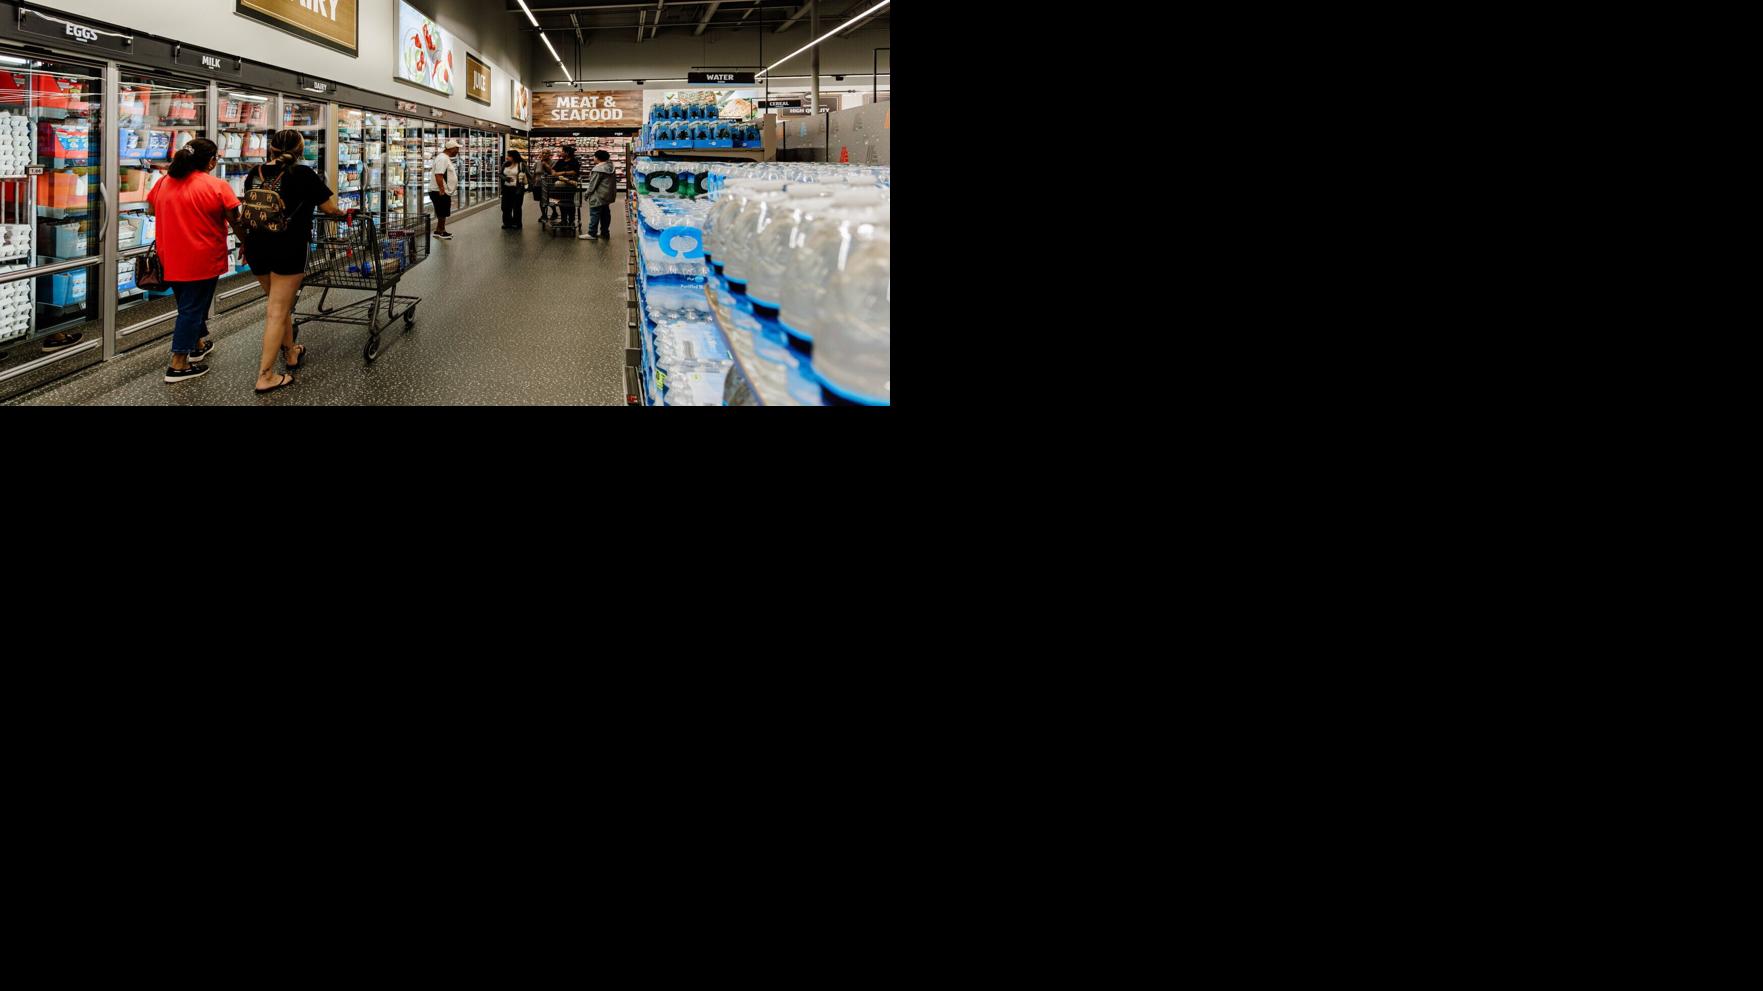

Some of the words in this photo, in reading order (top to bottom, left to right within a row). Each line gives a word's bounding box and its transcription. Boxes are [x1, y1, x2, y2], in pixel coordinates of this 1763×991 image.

[65, 23, 98, 41] EGGS
[202, 55, 220, 68] MILK
[556, 96, 599, 108] MEAT
[603, 96, 617, 108] &
[550, 108, 623, 120] SEAFOOD
